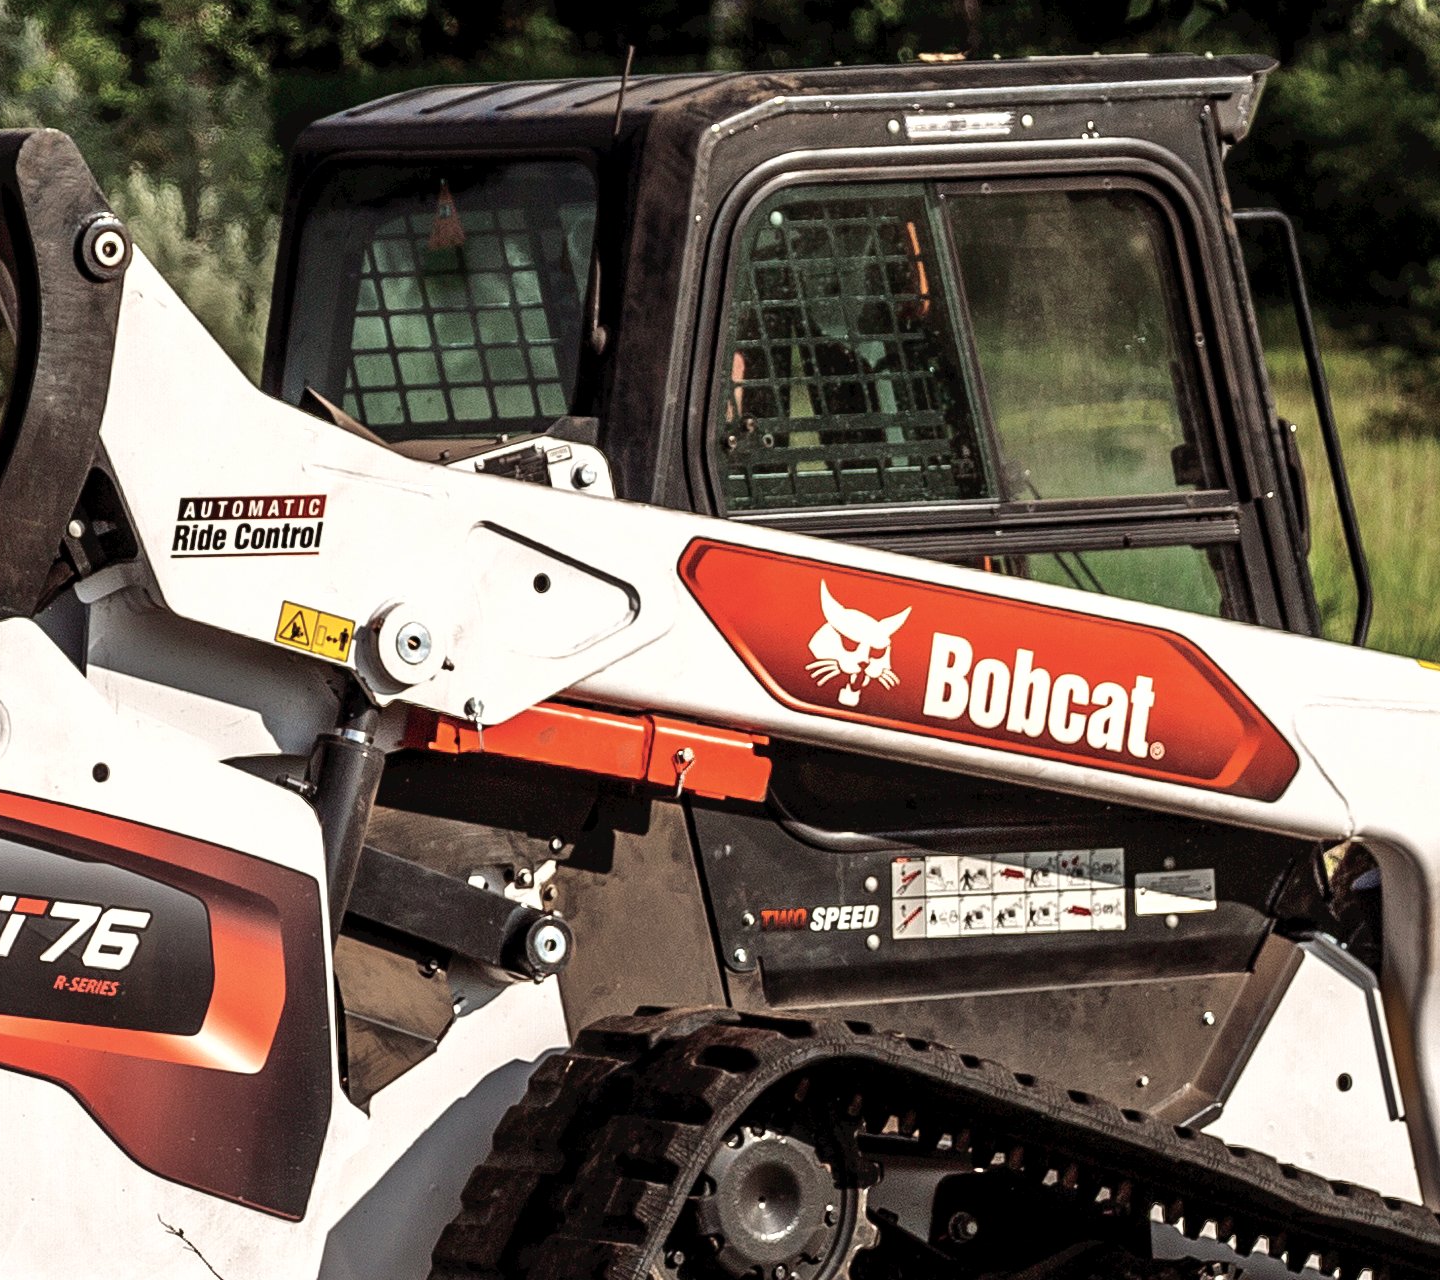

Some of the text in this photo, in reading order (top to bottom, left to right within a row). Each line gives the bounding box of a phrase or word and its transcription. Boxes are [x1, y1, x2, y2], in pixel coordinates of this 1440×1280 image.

[183, 498, 321, 519] AUTOMATIC
[171, 521, 324, 551] Ride Control
[922, 631, 1156, 759] Bobcat
[809, 904, 880, 932] SPEED
[52, 974, 120, 996] R-SERIES
